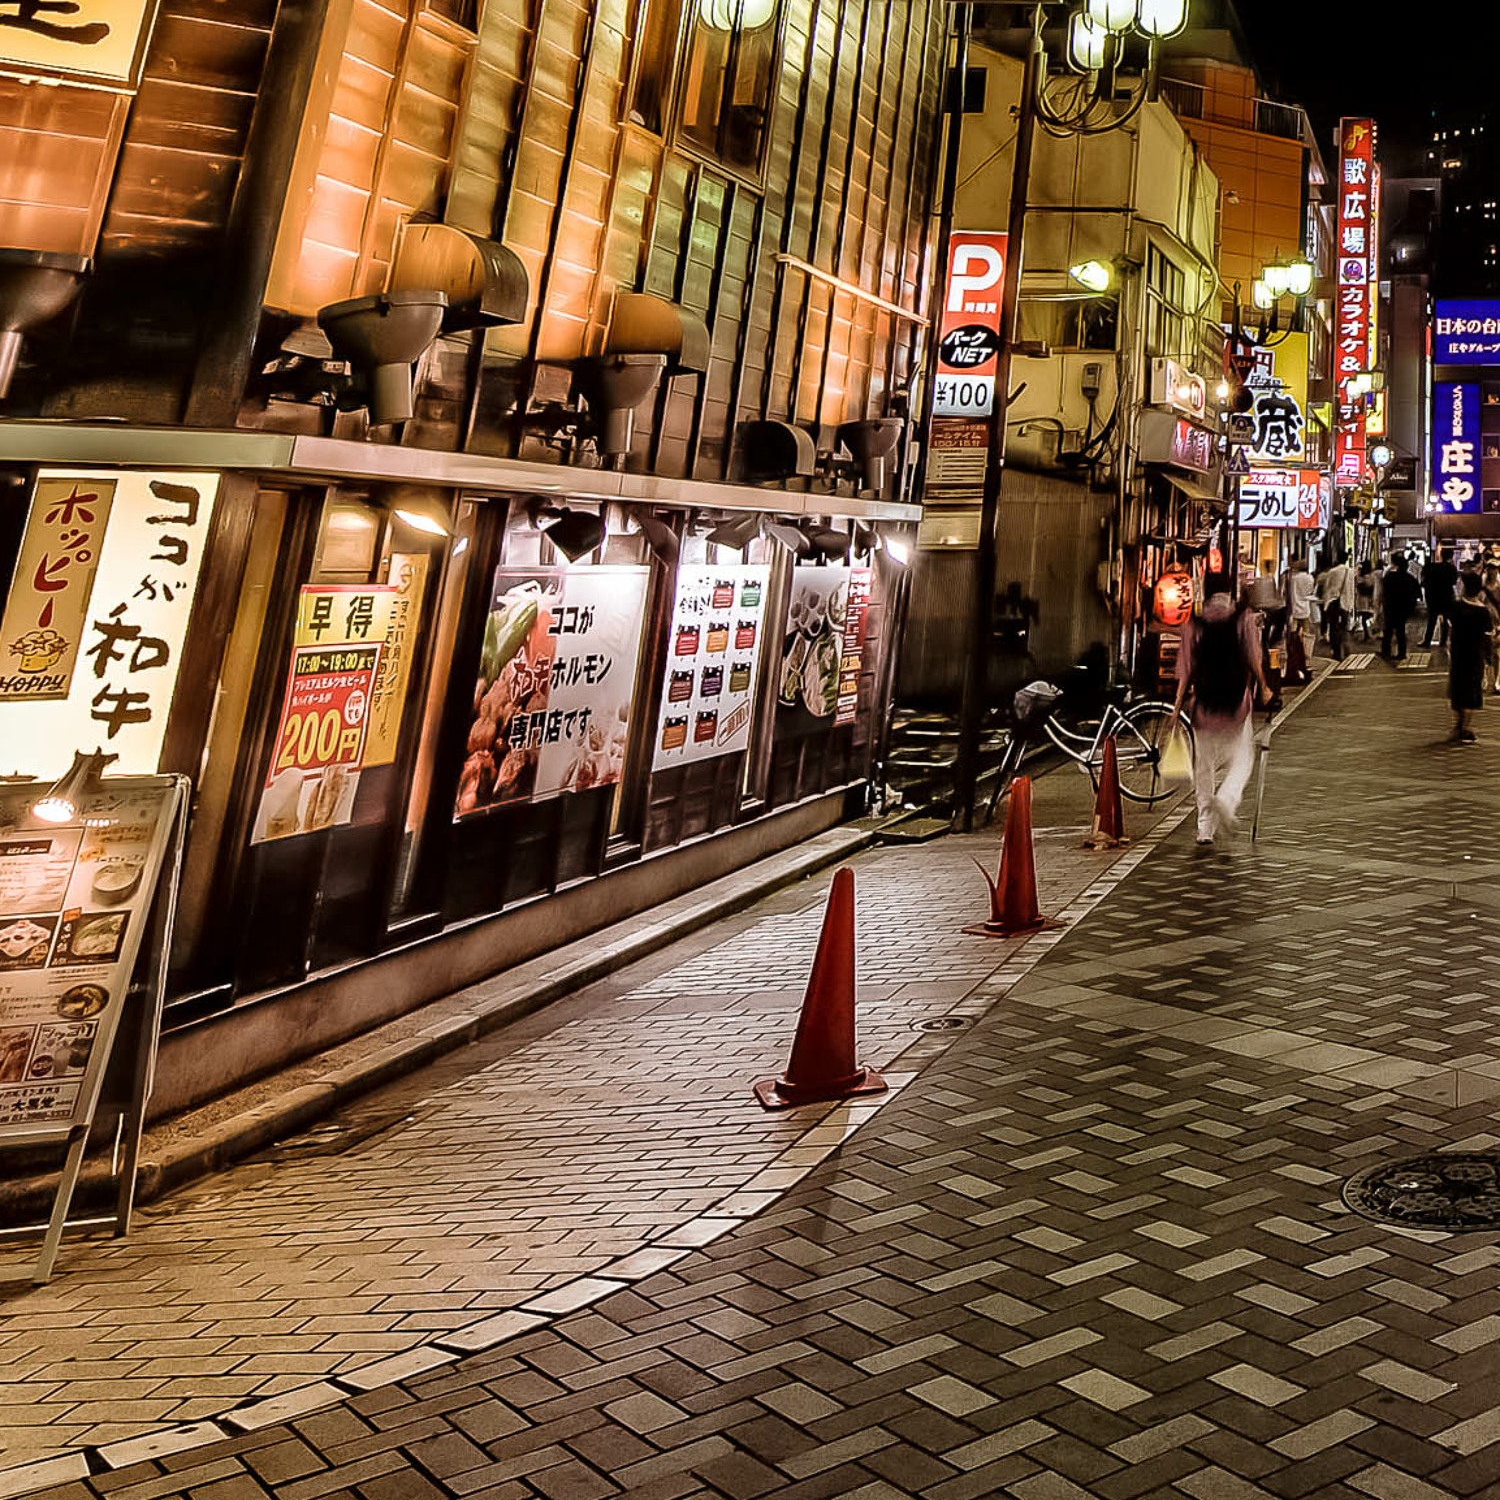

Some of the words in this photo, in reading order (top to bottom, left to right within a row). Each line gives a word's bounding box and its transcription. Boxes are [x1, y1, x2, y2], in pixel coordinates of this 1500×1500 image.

[1341, 157, 1368, 254] 歌広場
[944, 330, 988, 346] パーク
[950, 347, 993, 363] NET
[936, 380, 989, 408] ¥100
[1440, 439, 1475, 512] 庄や
[33, 484, 99, 628] ホッピー
[308, 595, 375, 641] 早得
[548, 605, 596, 635] ココが
[277, 709, 362, 769] 200円
